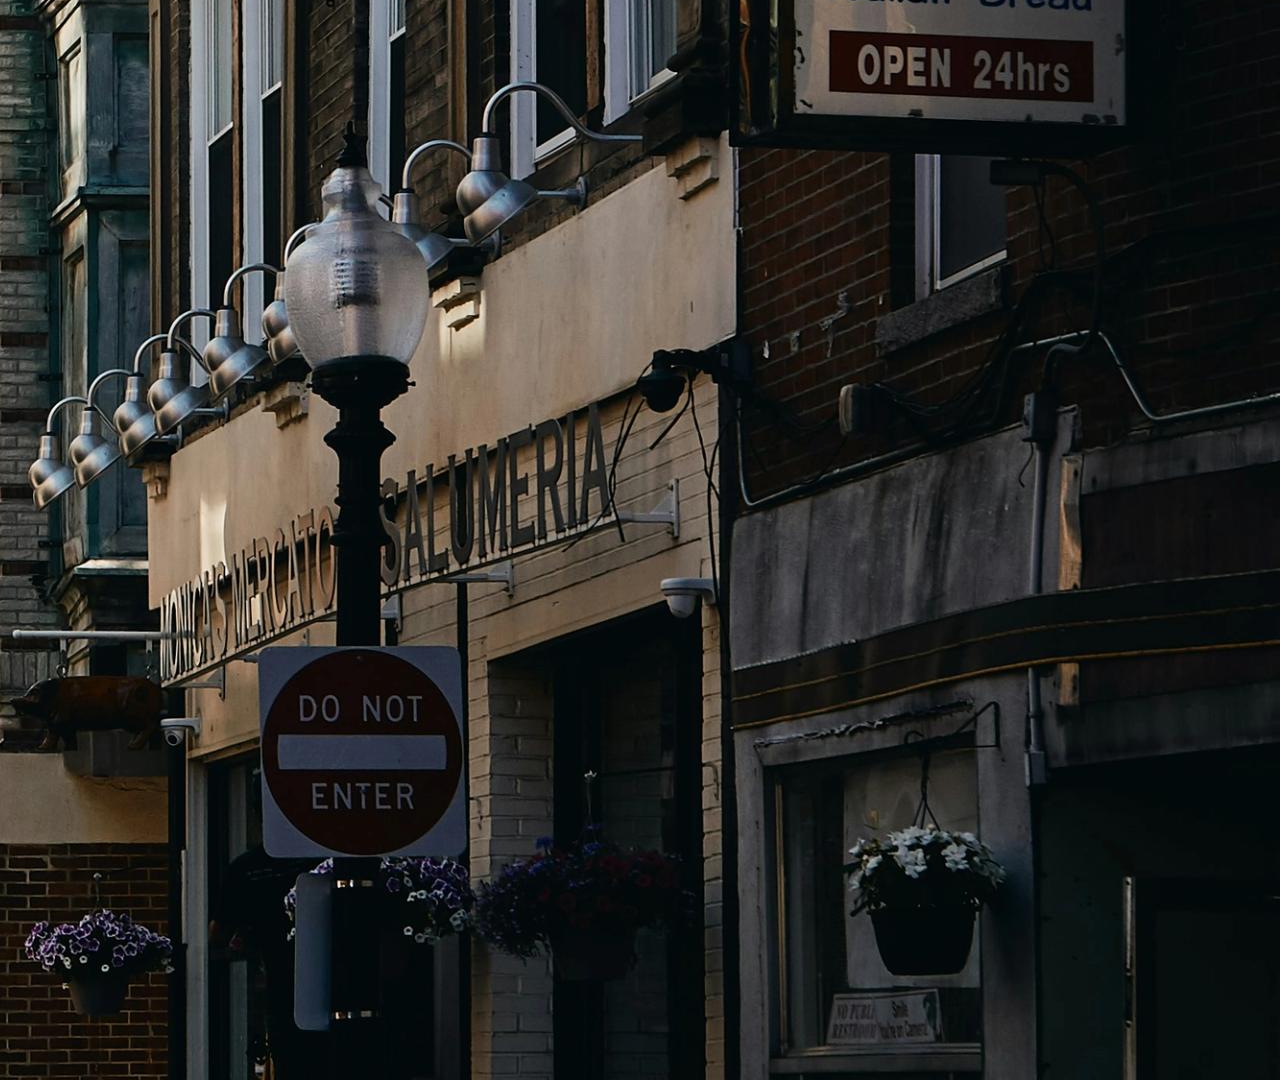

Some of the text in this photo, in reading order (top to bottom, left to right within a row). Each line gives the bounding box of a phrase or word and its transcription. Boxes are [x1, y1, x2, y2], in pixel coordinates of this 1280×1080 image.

[857, 44, 1071, 93] OPEN 24hrs
[160, 404, 611, 680] MONICA'S MERCATO SALUMERIA
[298, 695, 422, 722] DO NOT
[311, 782, 415, 810] ENTER
